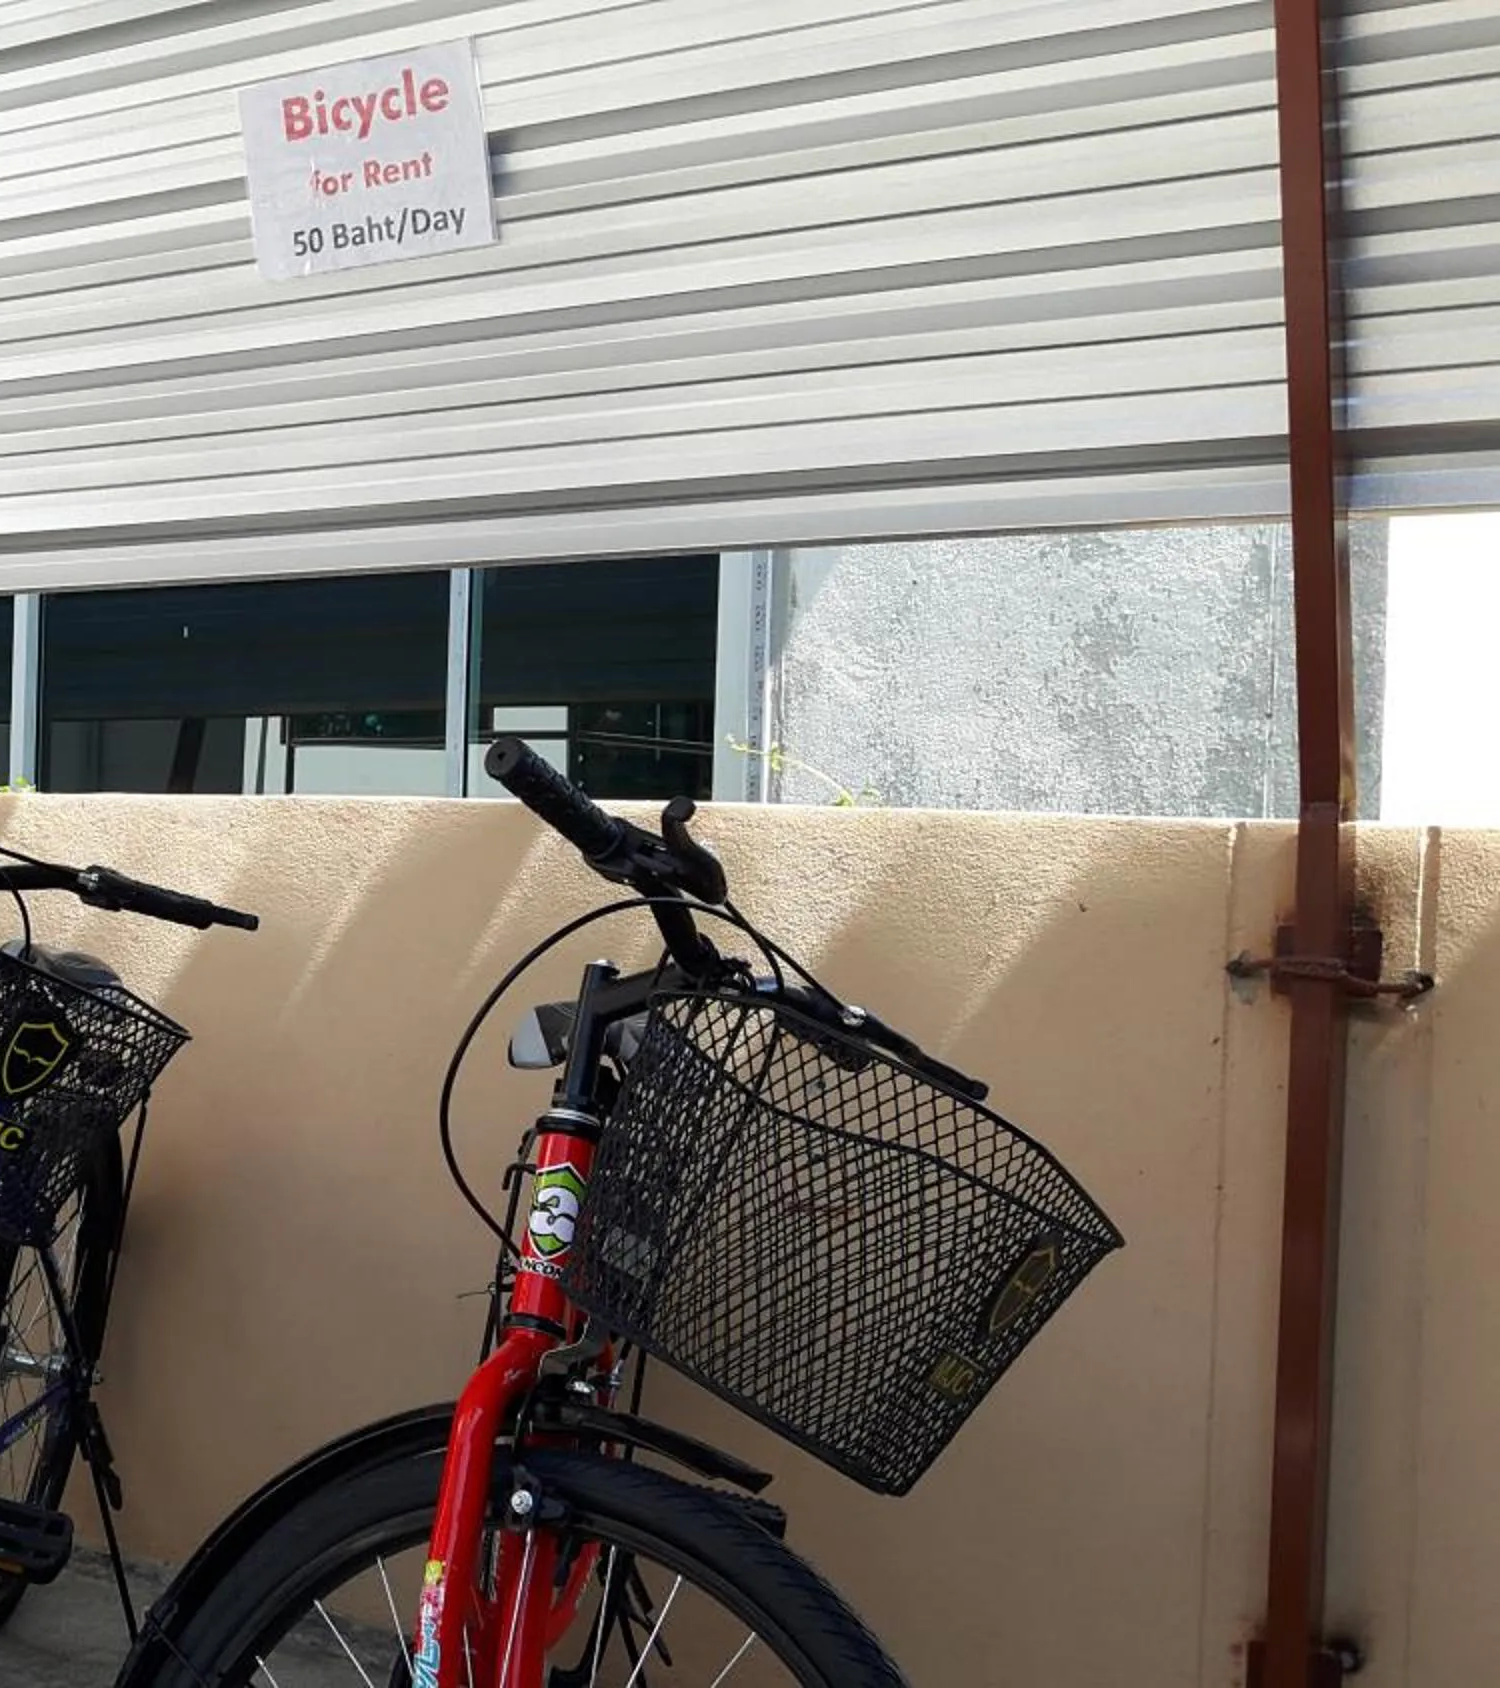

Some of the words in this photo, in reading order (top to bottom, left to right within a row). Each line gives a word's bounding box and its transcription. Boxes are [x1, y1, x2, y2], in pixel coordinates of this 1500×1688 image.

[281, 67, 450, 142] Bicycle
[311, 169, 353, 196] for
[362, 152, 433, 188] Rent
[293, 227, 324, 256] 50
[332, 207, 466, 249] Baht/Day
